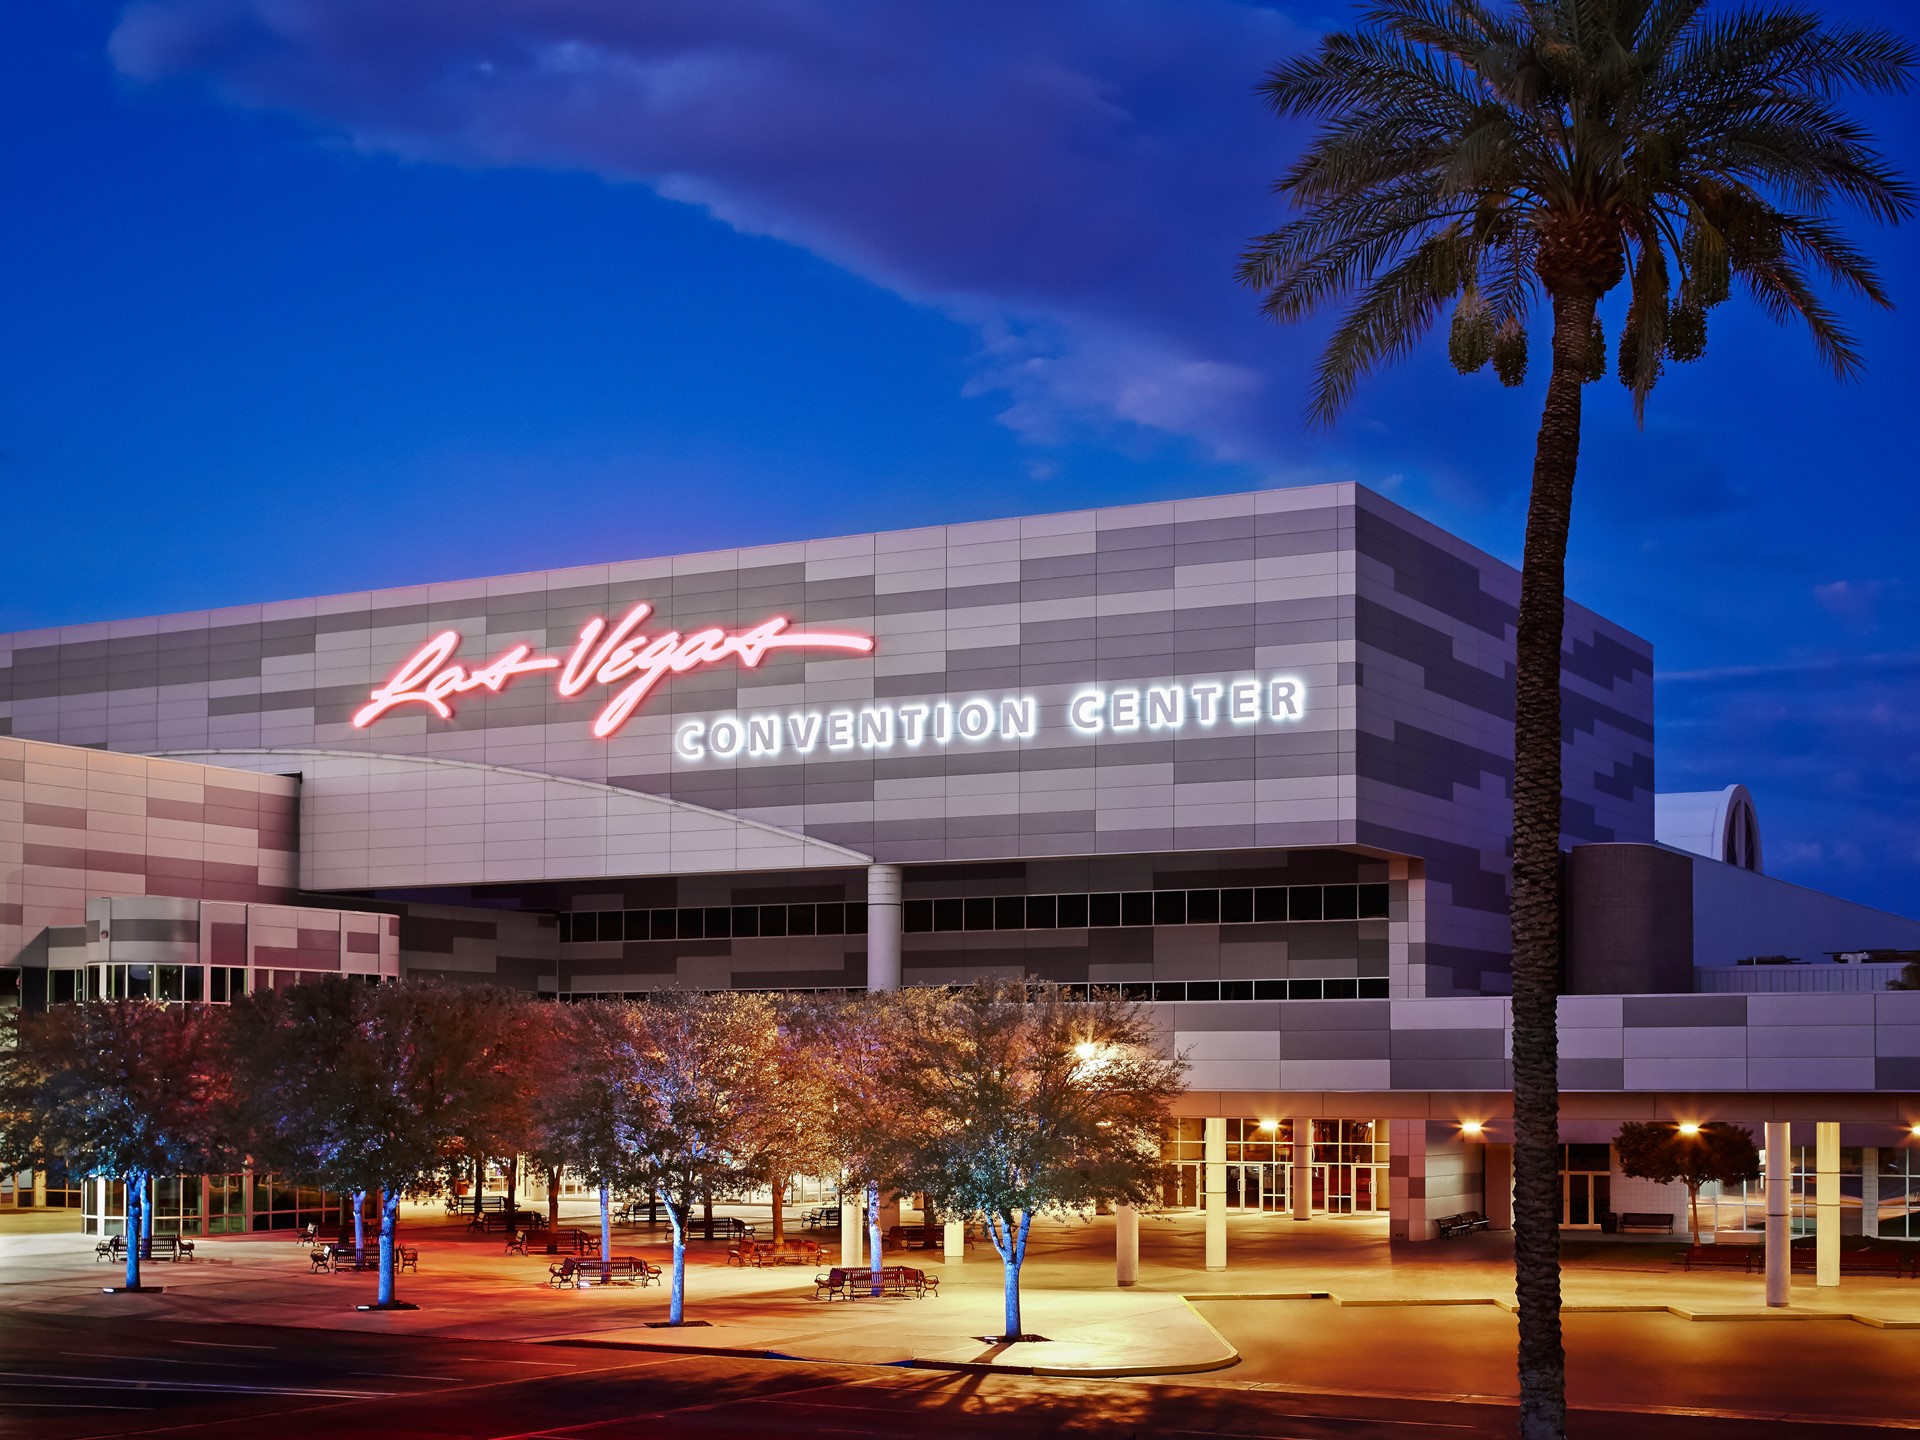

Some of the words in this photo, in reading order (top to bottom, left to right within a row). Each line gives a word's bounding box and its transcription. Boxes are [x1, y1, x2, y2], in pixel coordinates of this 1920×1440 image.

[353, 631, 561, 728] Las
[559, 603, 875, 737] Vegas
[677, 699, 1033, 758] CONVENTION
[1071, 680, 1301, 730] CENTER
